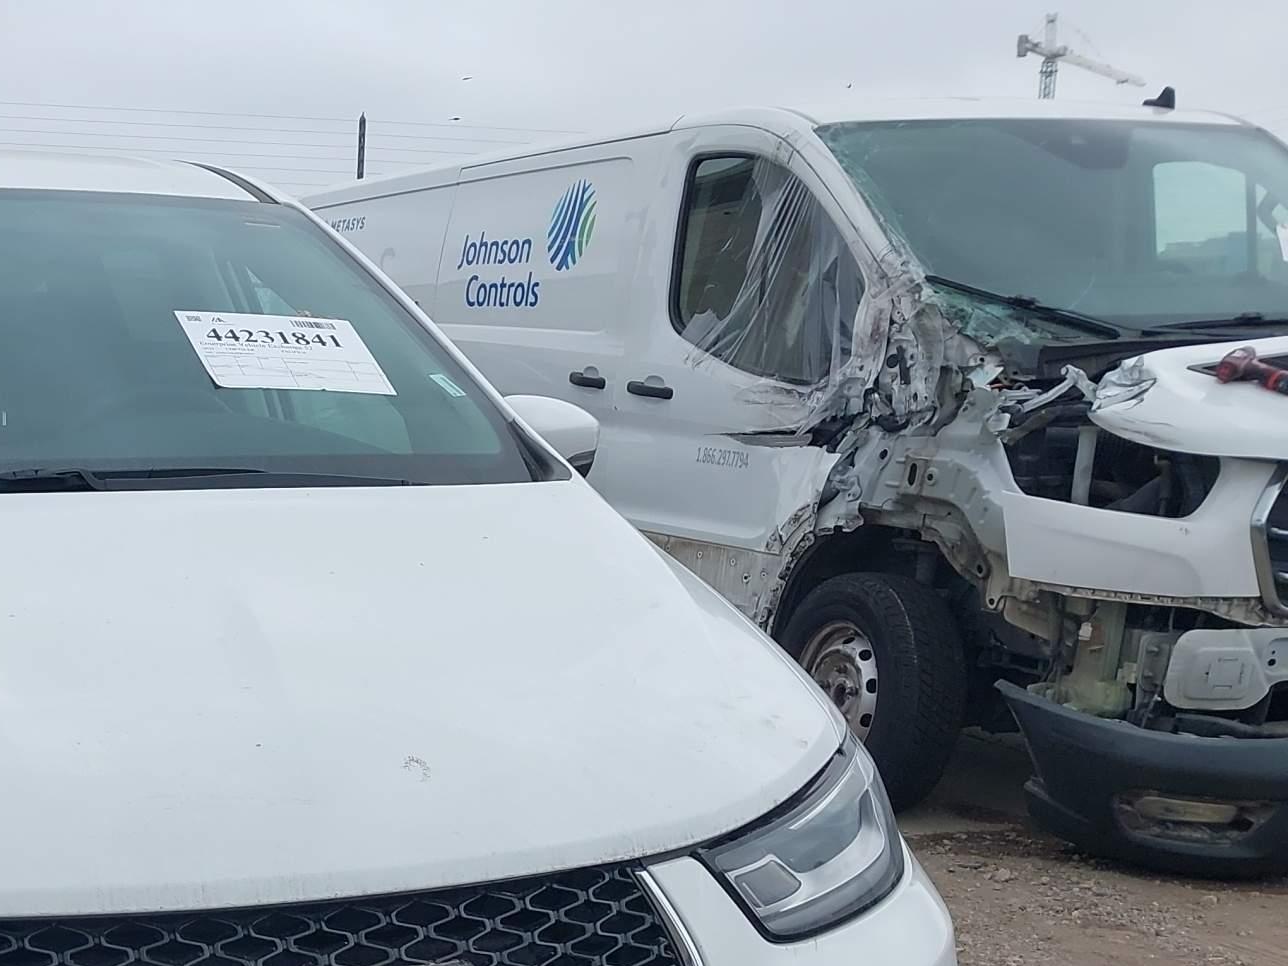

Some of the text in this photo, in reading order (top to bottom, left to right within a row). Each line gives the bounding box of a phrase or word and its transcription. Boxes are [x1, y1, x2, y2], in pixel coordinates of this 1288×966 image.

[457, 231, 532, 270] Johnson
[465, 271, 540, 307] Controls
[206, 327, 345, 348] 44231841
